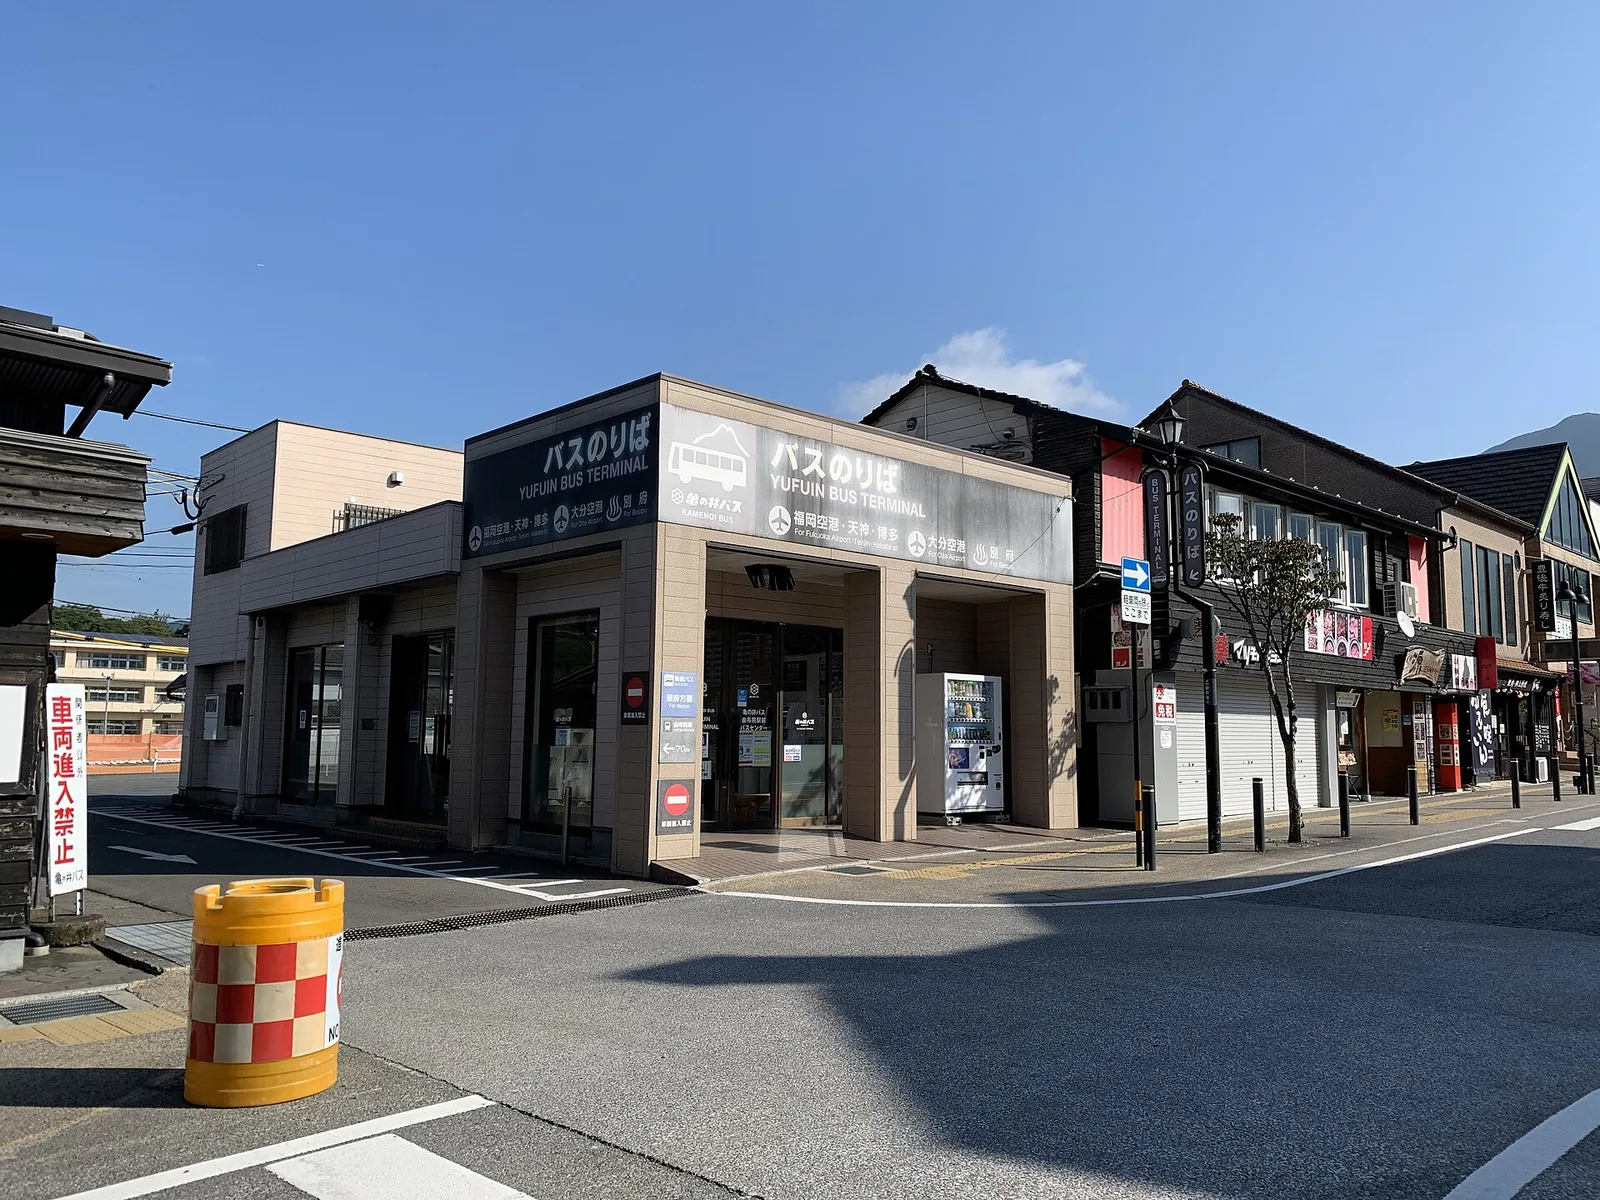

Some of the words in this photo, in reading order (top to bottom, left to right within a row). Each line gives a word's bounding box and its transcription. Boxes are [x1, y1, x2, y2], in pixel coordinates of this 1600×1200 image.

[543, 412, 652, 474] バスのりば
[520, 478, 558, 500] YUFUIN
[560, 471, 583, 490] BUS
[587, 455, 649, 483] TERMINAL
[770, 442, 899, 493] バスのりば
[770, 474, 825, 498] YUFUIN
[829, 486, 857, 504] BUS
[861, 493, 926, 518] TERMINAL
[1151, 478, 1159, 502] BUS
[571, 500, 603, 519] 大分空港
[685, 492, 742, 513] 亀の井バス
[682, 508, 717, 521] KAMENOI
[719, 514, 734, 524] BUS
[1184, 472, 1200, 559] バスのりば
[794, 528, 805, 536] For
[805, 530, 830, 541] Fukuoka
[928, 535, 966, 553] 大分空港
[1153, 506, 1161, 570] TERMINAL
[949, 554, 966, 562] Airport
[1124, 607, 1149, 620] ここまで
[666, 694, 693, 703] 別府方面
[75, 697, 83, 778] 関係者以外
[51, 695, 75, 865] 車両進入禁止
